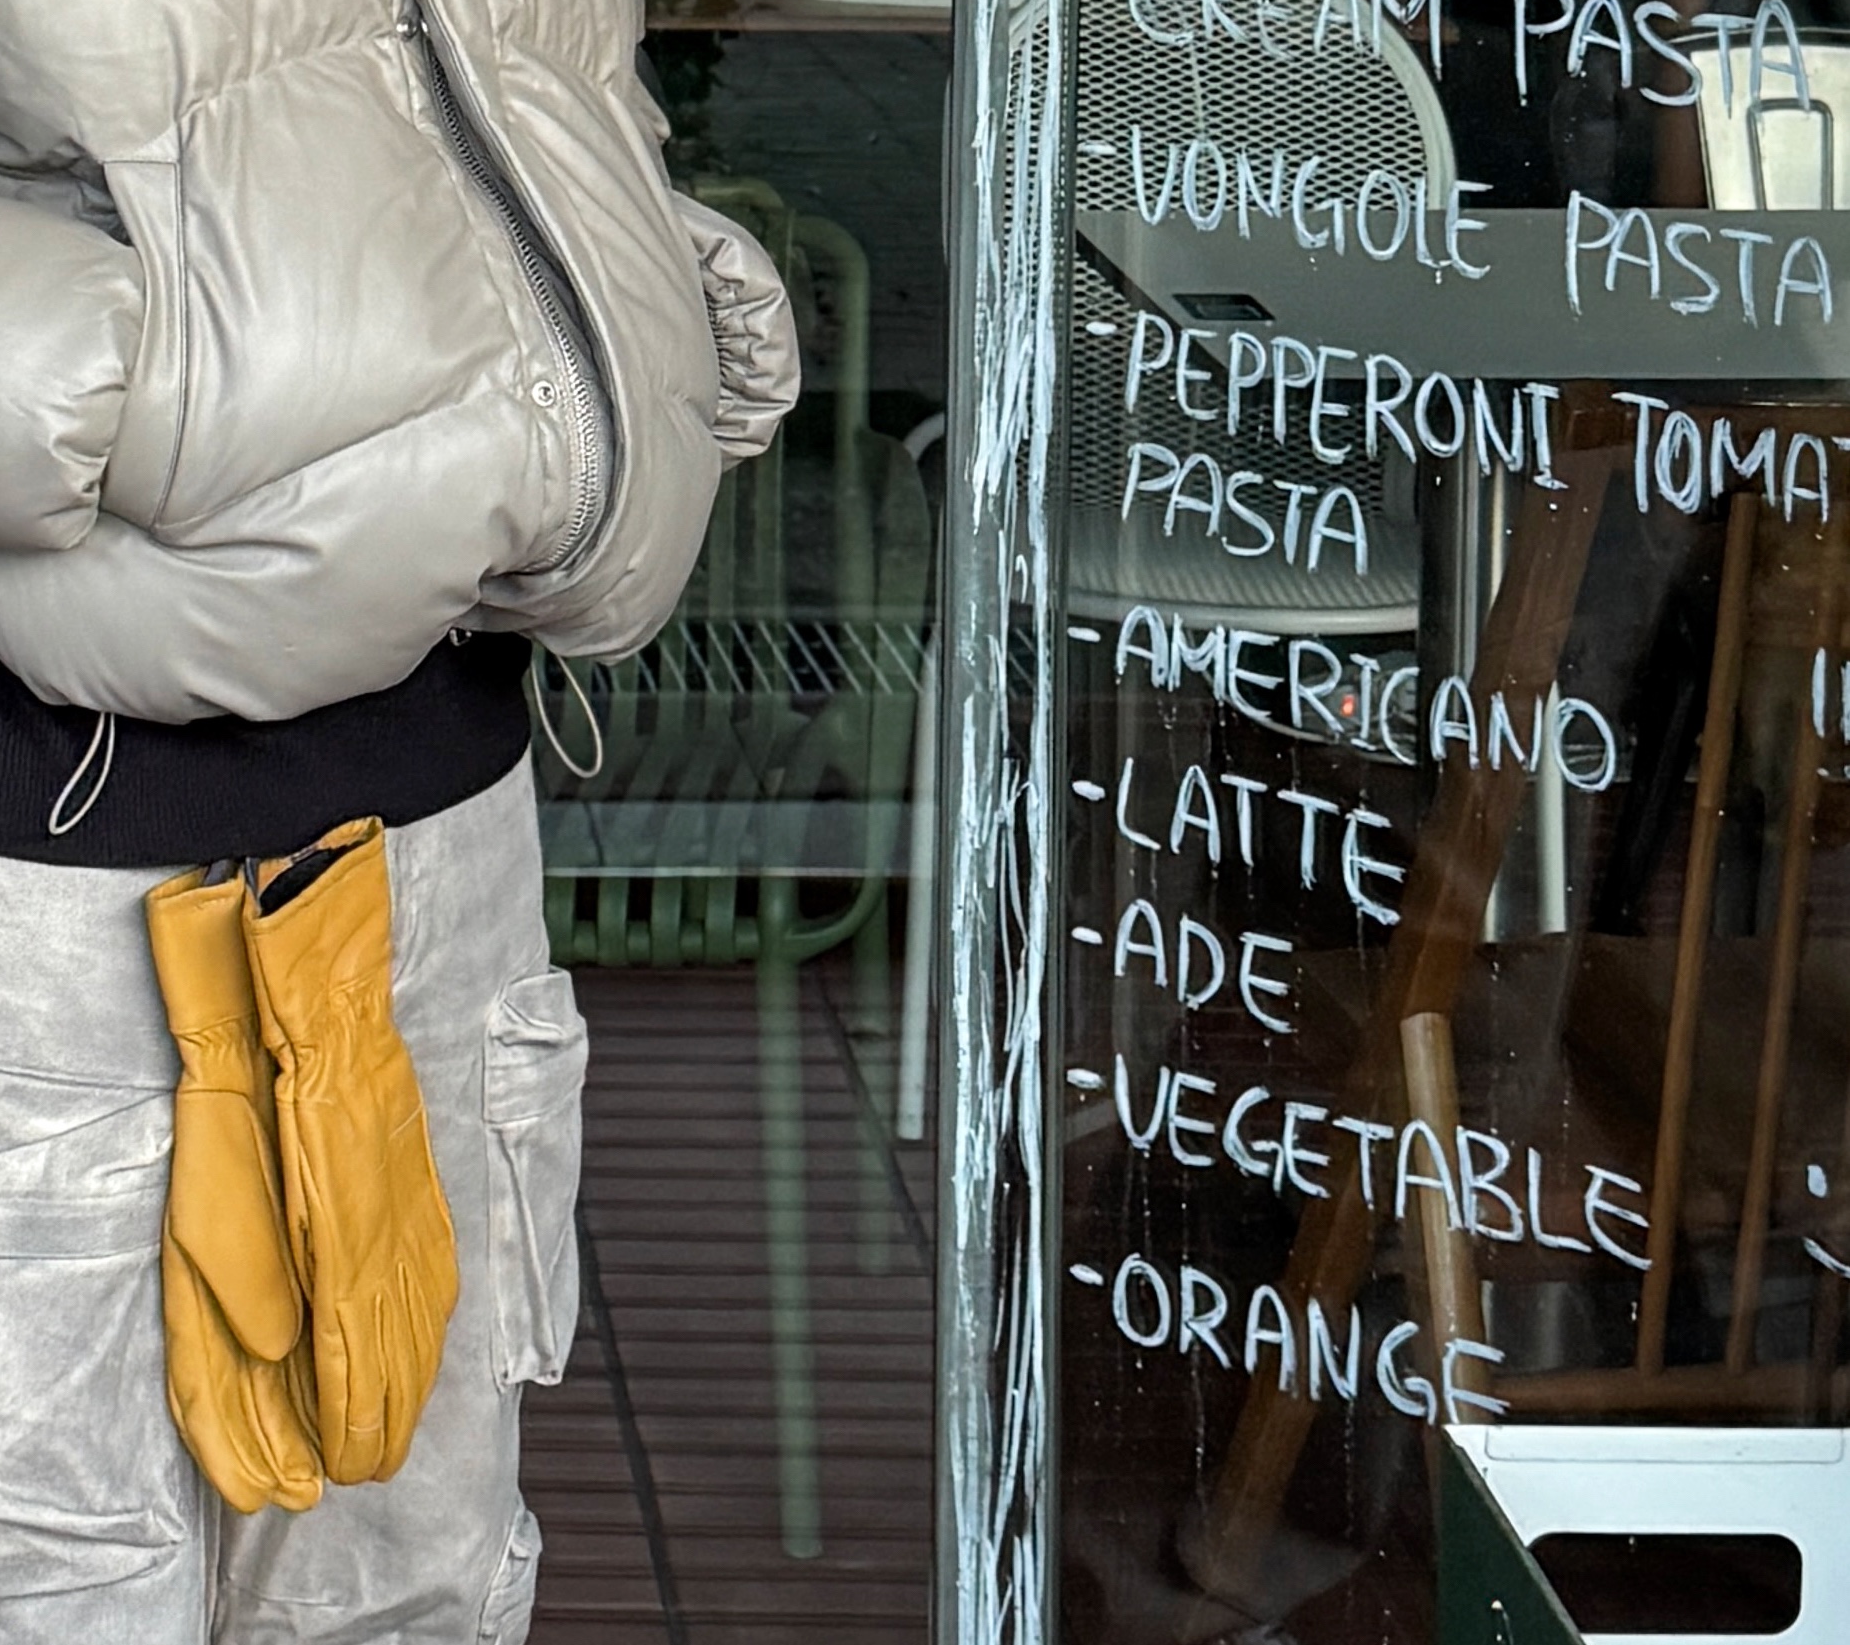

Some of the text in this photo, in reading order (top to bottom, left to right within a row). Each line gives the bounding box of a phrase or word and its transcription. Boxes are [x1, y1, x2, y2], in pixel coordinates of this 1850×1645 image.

[1565, 190, 1833, 326] PASTA
[1122, 443, 1368, 575] PASTA
[1612, 392, 1850, 524] TOMA
